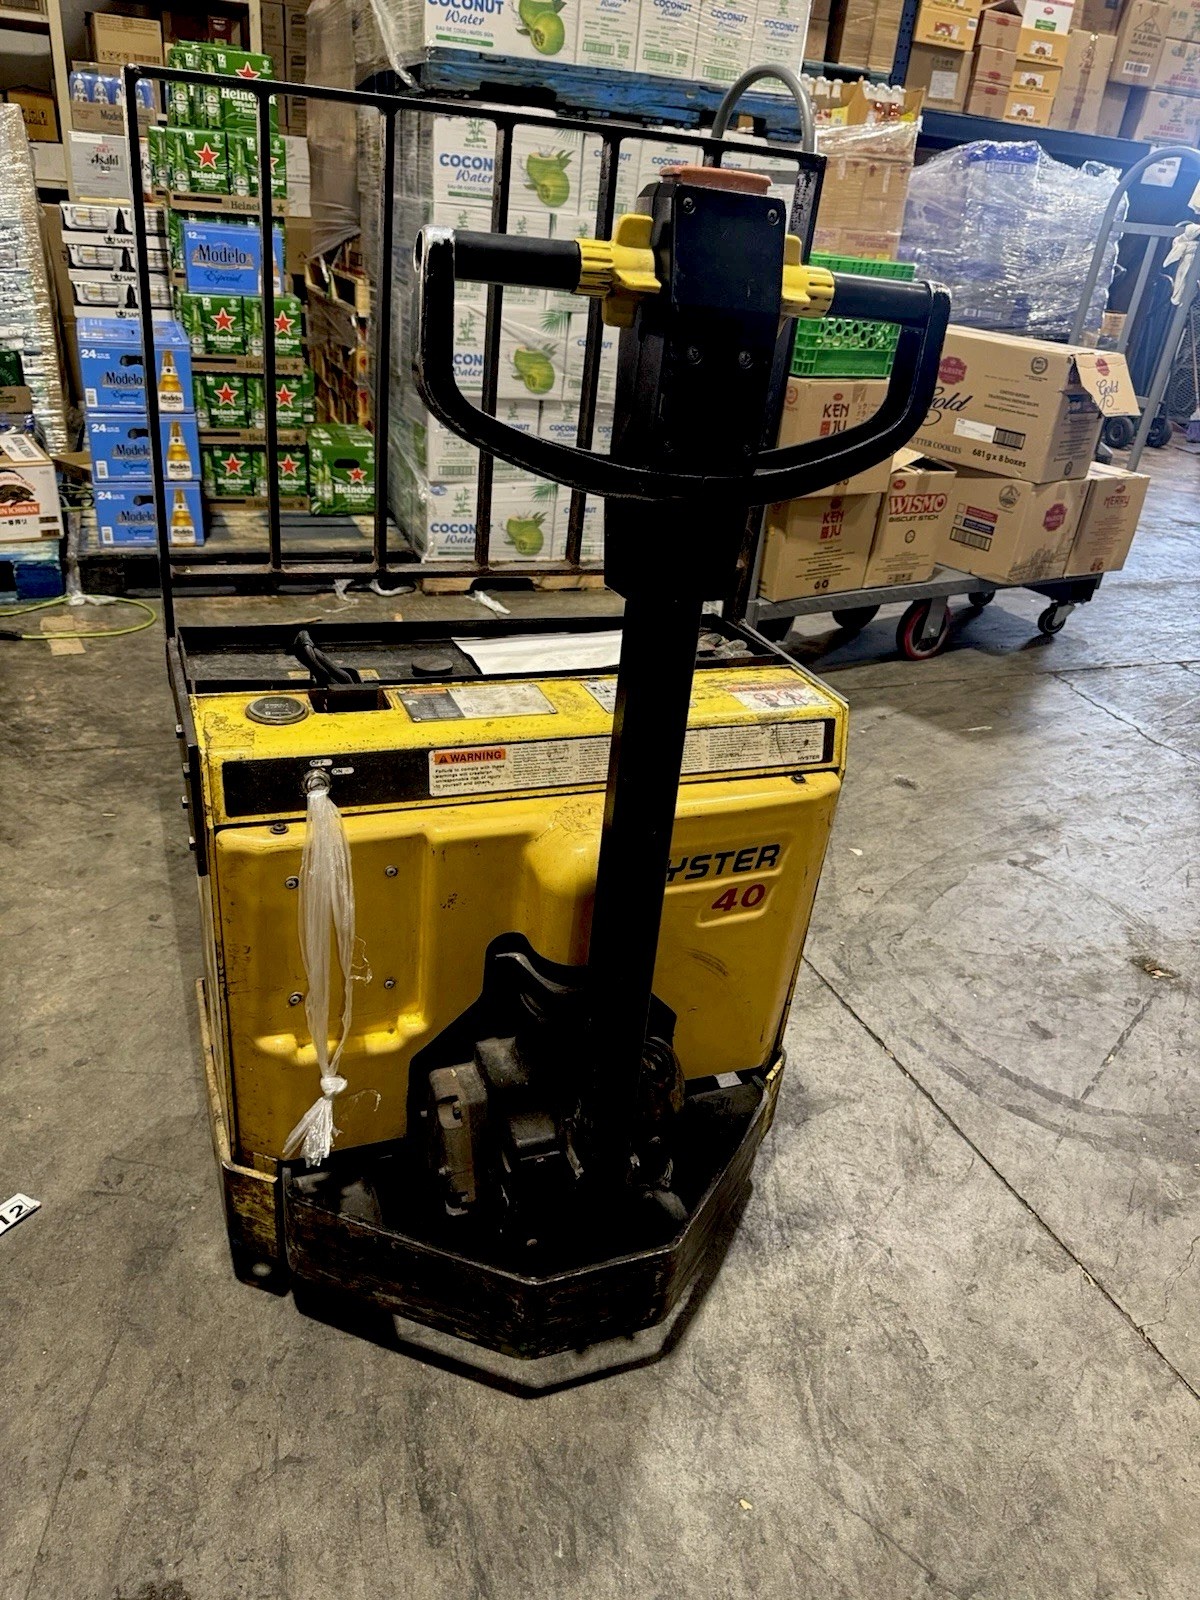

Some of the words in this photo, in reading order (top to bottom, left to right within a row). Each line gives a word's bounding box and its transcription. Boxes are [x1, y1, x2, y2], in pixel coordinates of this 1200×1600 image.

[428, 0, 503, 15] CONUT
[445, 9, 485, 26] Water
[711, 9, 748, 23] COCONUT
[764, 19, 799, 33] COCONUT
[221, 87, 277, 104] Heinen
[440, 153, 493, 171] COCON
[191, 170, 226, 180] Heineken
[456, 169, 493, 184] Water
[231, 200, 259, 211] Heine
[187, 231, 198, 239] 12
[199, 244, 247, 264] Modelo
[204, 270, 242, 284] Especial
[81, 349, 96, 359] 24
[106, 371, 143, 386] Modelo
[1096, 379, 1119, 408] Gold
[823, 404, 849, 418] KEN
[91, 424, 107, 433] 24
[550, 424, 577, 432] COCON
[911, 438, 932, 447] UTTER
[933, 441, 961, 454] COOKIES
[973, 448, 986, 457] 681
[999, 454, 1004, 462] 8
[1004, 455, 1027, 467] boxes
[335, 483, 374, 494] Heineke
[98, 492, 112, 500] 24
[889, 493, 947, 515] WISMO
[823, 510, 844, 524] KEN
[431, 523, 477, 534] COCON
[830, 525, 843, 538] JU
[450, 751, 502, 762] WARNING
[666, 843, 780, 882] YSTER
[711, 883, 766, 911] 40
